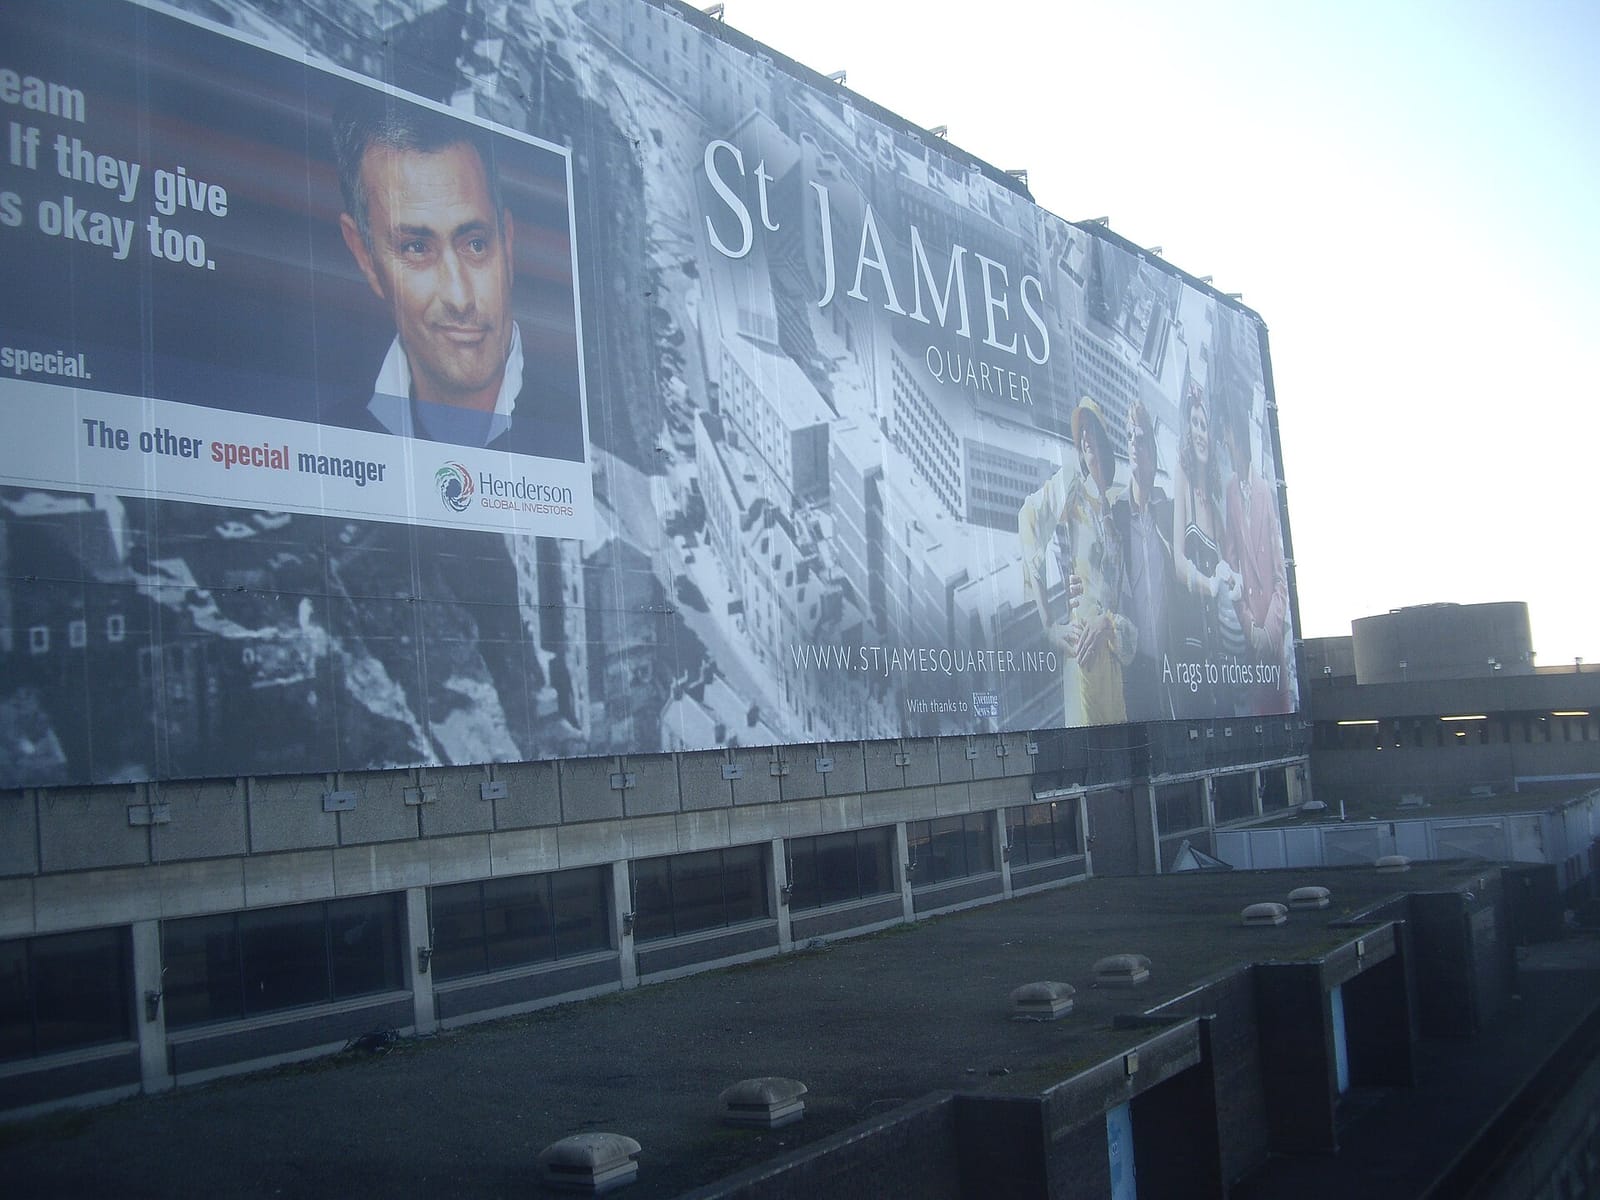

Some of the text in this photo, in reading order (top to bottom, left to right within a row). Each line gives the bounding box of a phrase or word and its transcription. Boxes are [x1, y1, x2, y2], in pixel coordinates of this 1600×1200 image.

[9, 121, 228, 217] If they give
[38, 195, 135, 260] okay
[146, 215, 216, 271] too.
[704, 139, 1051, 366] St JAMES
[1, 347, 92, 380] special.
[926, 345, 1034, 406] QUARTER
[82, 418, 387, 487] The other special manager
[479, 472, 573, 504] Henderson
[480, 497, 574, 517] GLOBAL INVESTORS
[790, 644, 1058, 677] WWW.STJAMESQUARTER.INFO
[1162, 653, 1281, 692] A rags to riches story
[906, 698, 968, 713] With thanks to
